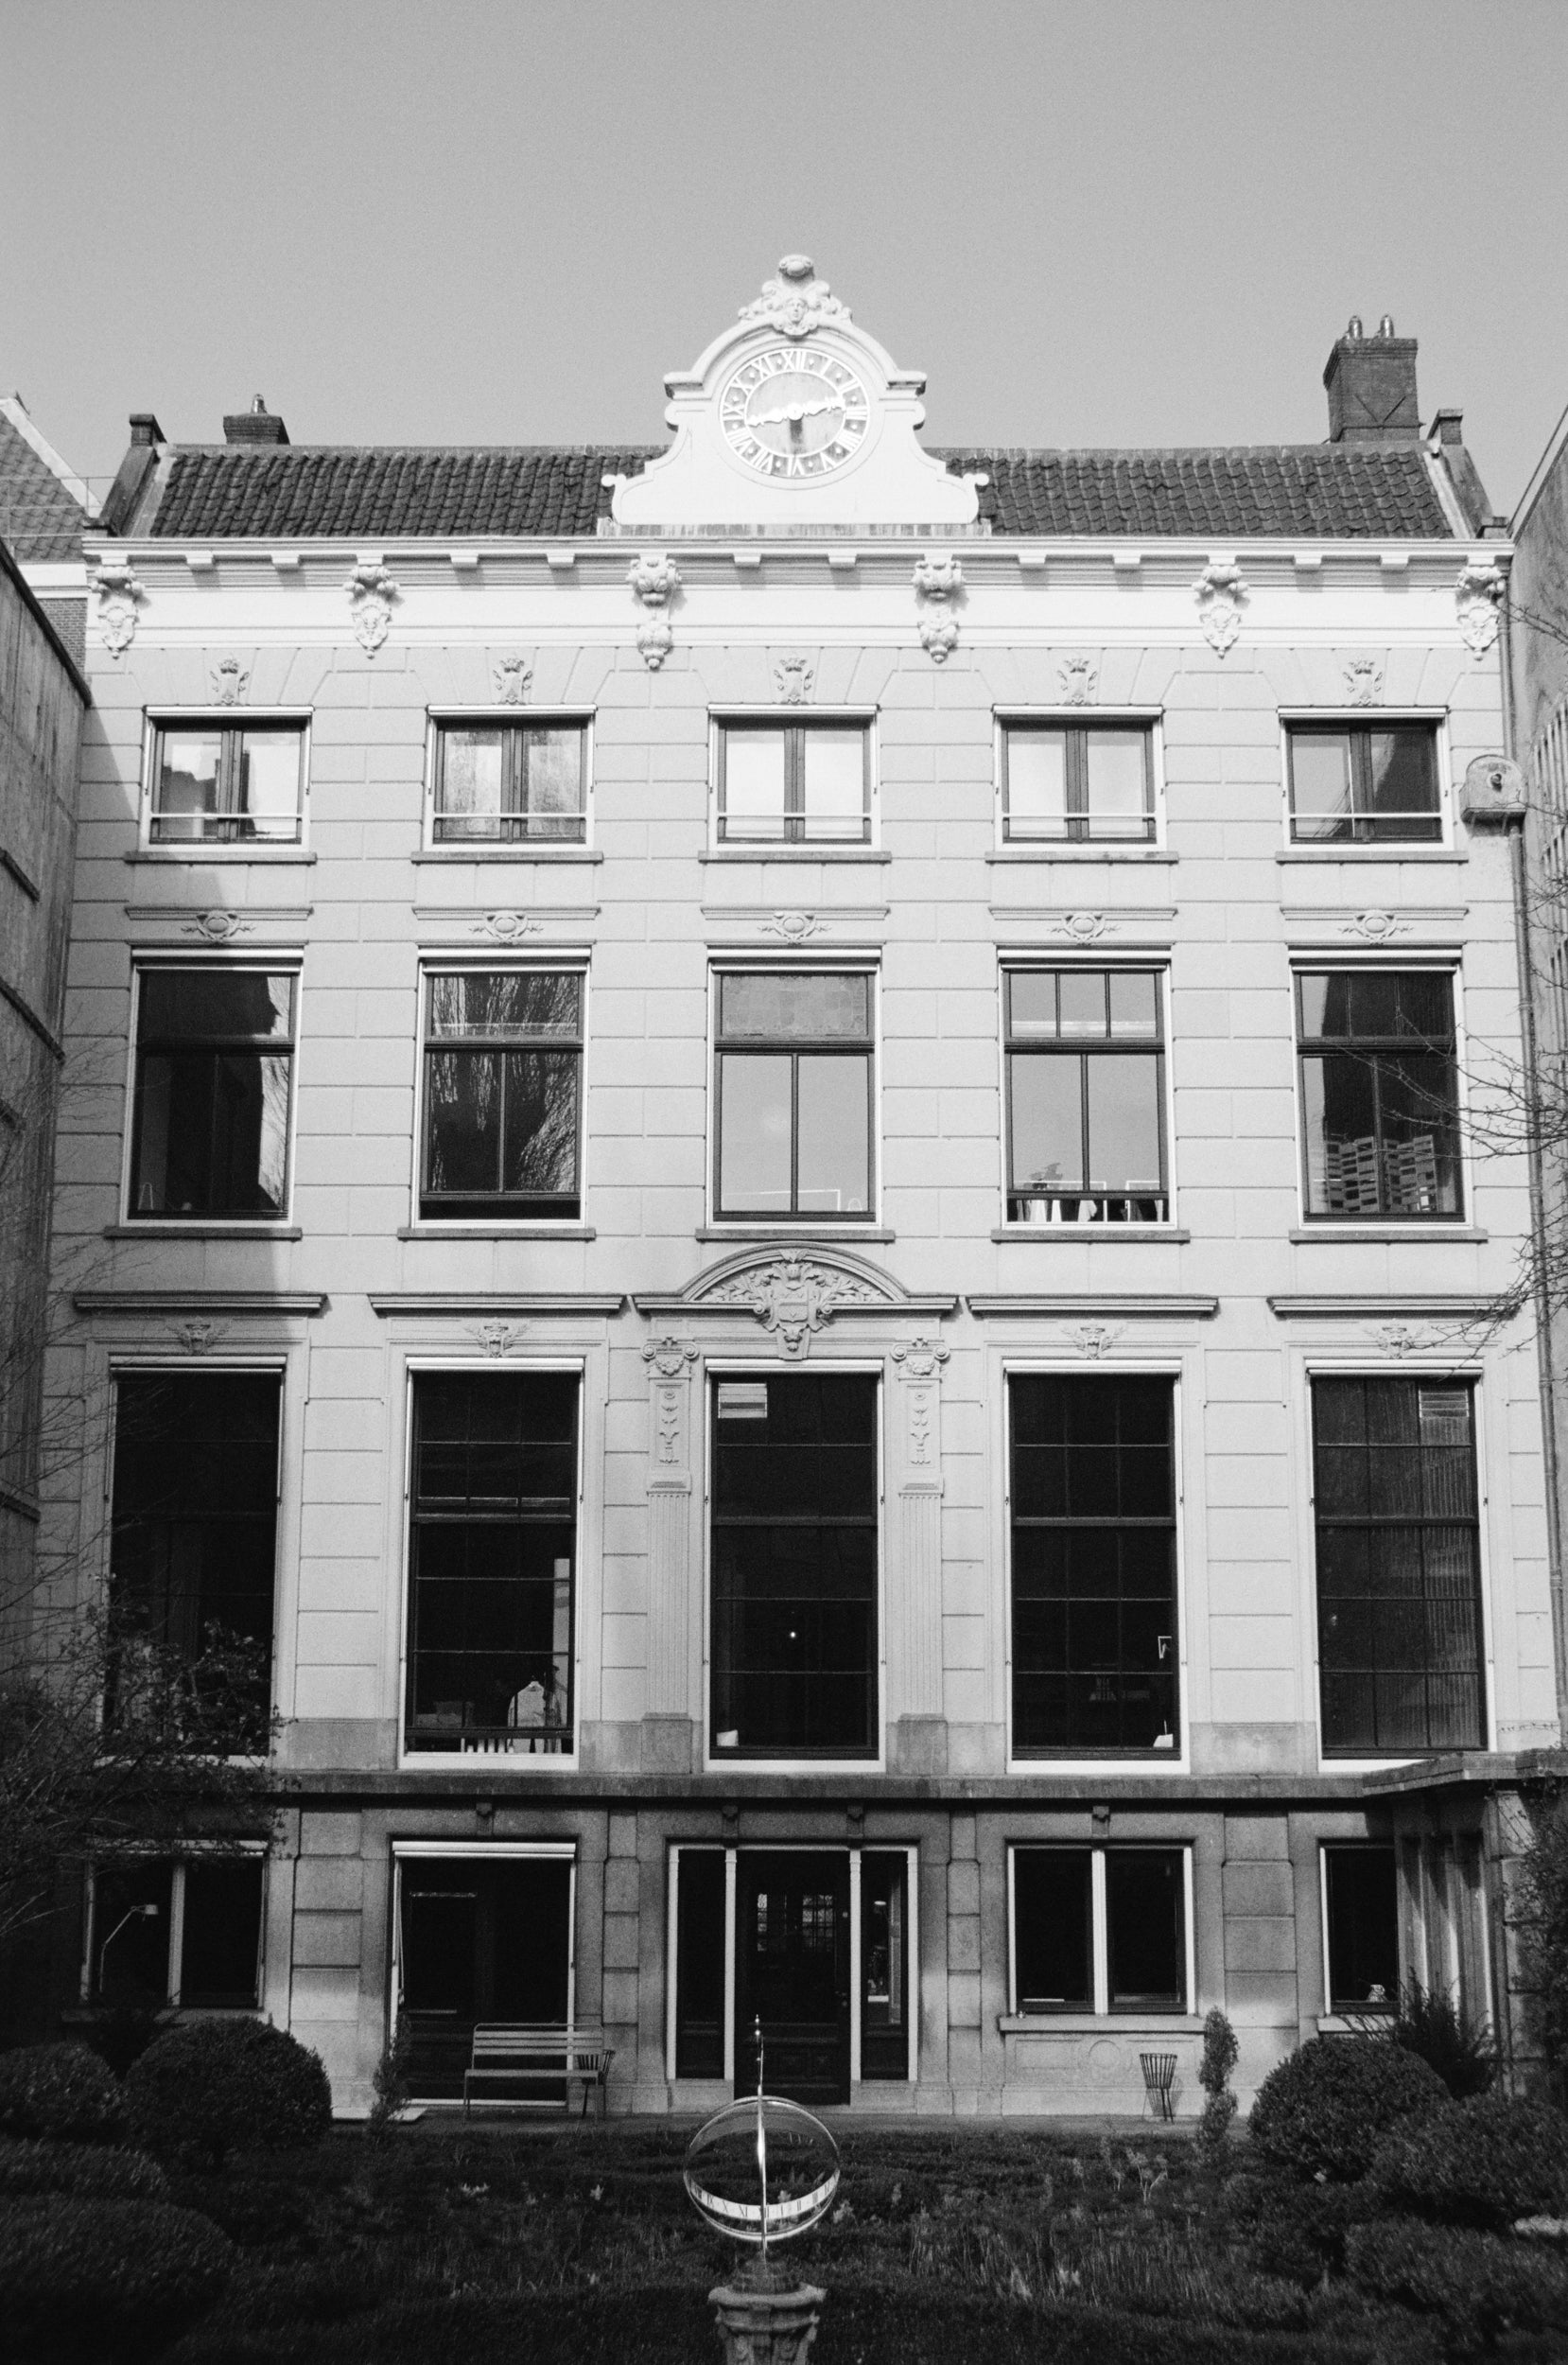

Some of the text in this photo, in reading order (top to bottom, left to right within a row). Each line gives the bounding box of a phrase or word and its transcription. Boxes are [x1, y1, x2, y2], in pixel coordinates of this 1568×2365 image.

[750, 355, 775, 378] XI
[780, 350, 807, 372] XII
[820, 356, 834, 377] I
[729, 377, 754, 396] X
[837, 377, 861, 394] II
[722, 402, 745, 421] IX
[845, 406, 868, 420] III
[725, 428, 755, 455] VIII
[750, 447, 774, 475] VII
[787, 455, 805, 476] VI
[819, 451, 837, 472] V
